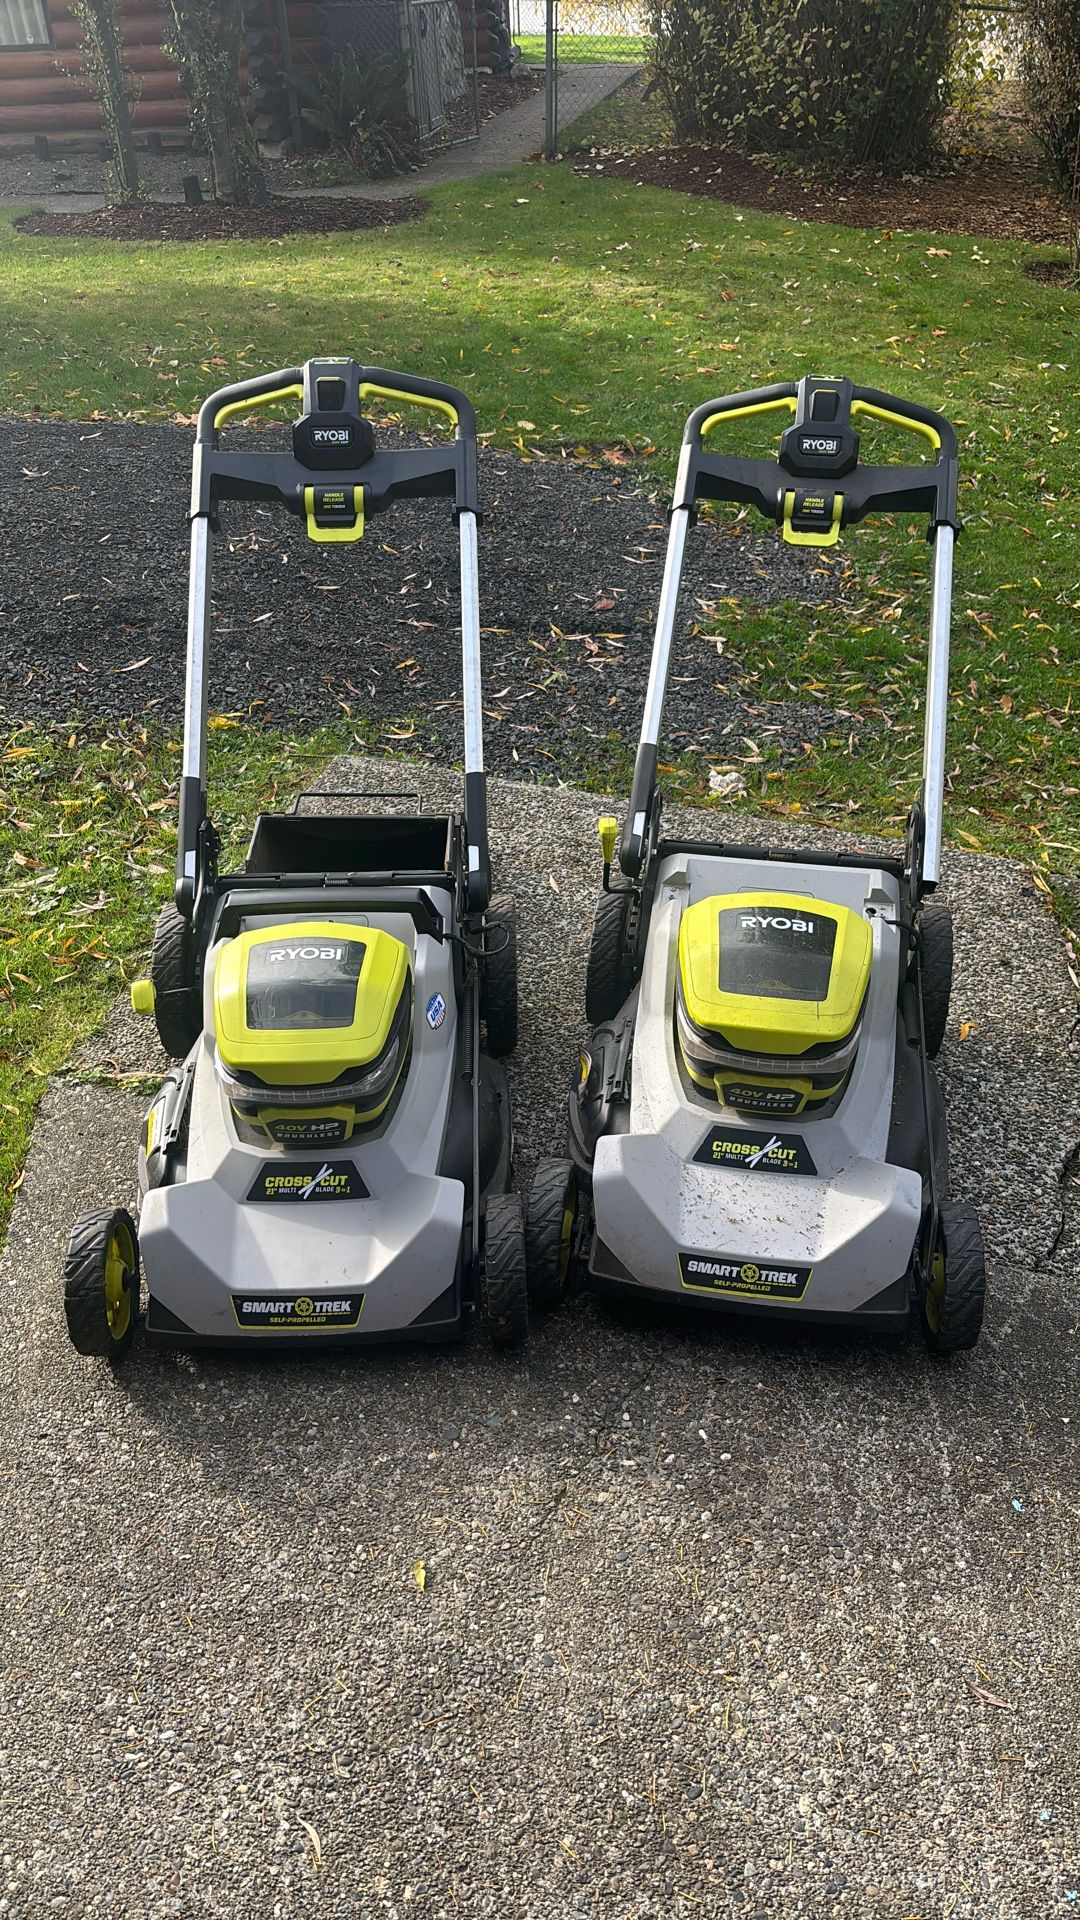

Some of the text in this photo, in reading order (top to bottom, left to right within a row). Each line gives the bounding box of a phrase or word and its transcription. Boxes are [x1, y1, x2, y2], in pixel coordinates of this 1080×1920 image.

[313, 430, 349, 441] RYOBI
[802, 439, 837, 451] RYOBI
[740, 916, 814, 934] RYOBI
[269, 947, 343, 962] RYOBI
[430, 1000, 443, 1022] USA
[730, 1088, 763, 1098] 40V
[729, 1096, 794, 1108] BRUSHLESS
[311, 1122, 340, 1131] HP
[277, 1131, 340, 1139] BRUSHLESS
[712, 1141, 797, 1160] CROSS CUT
[725, 1152, 743, 1160] MULTI
[762, 1157, 781, 1165] BLADE
[265, 1175, 348, 1188] CROSS CUT
[687, 1260, 799, 1284] SMART TREK
[714, 1279, 771, 1292] SELF-PROPELLED
[242, 1300, 352, 1313] SMART TREK
